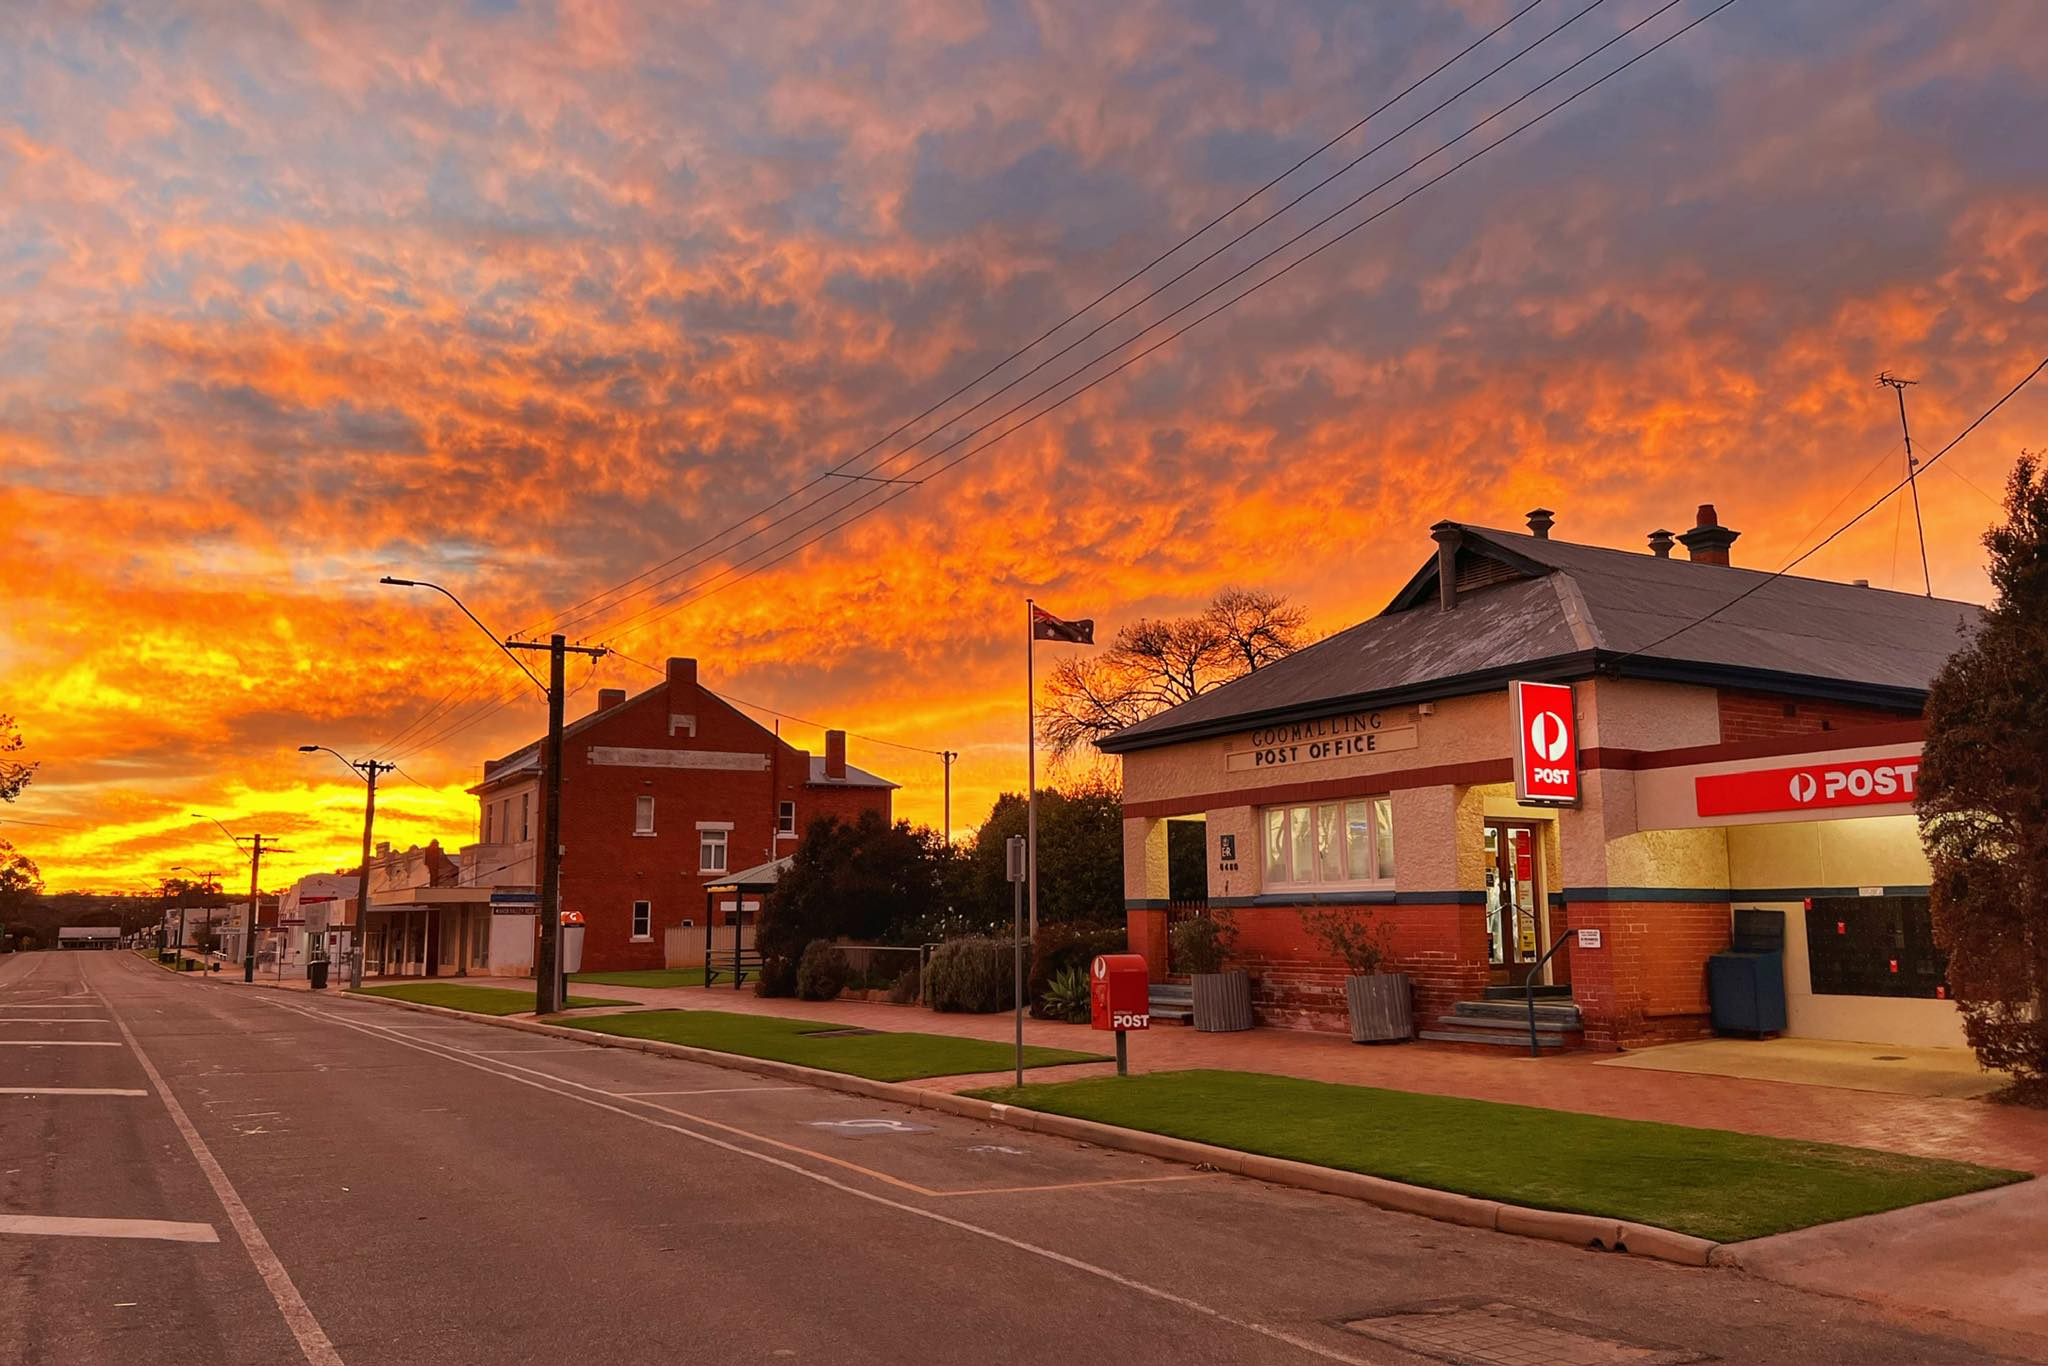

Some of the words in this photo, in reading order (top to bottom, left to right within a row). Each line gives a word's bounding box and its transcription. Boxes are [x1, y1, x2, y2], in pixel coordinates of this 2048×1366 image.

[1252, 713, 1382, 747] GOOMALLING
[1255, 747, 1298, 766] POST
[1309, 735, 1376, 759] OFFICE
[1533, 768, 1570, 785] POST
[1824, 764, 1919, 799] POST
[1113, 1014, 1150, 1028] POST
